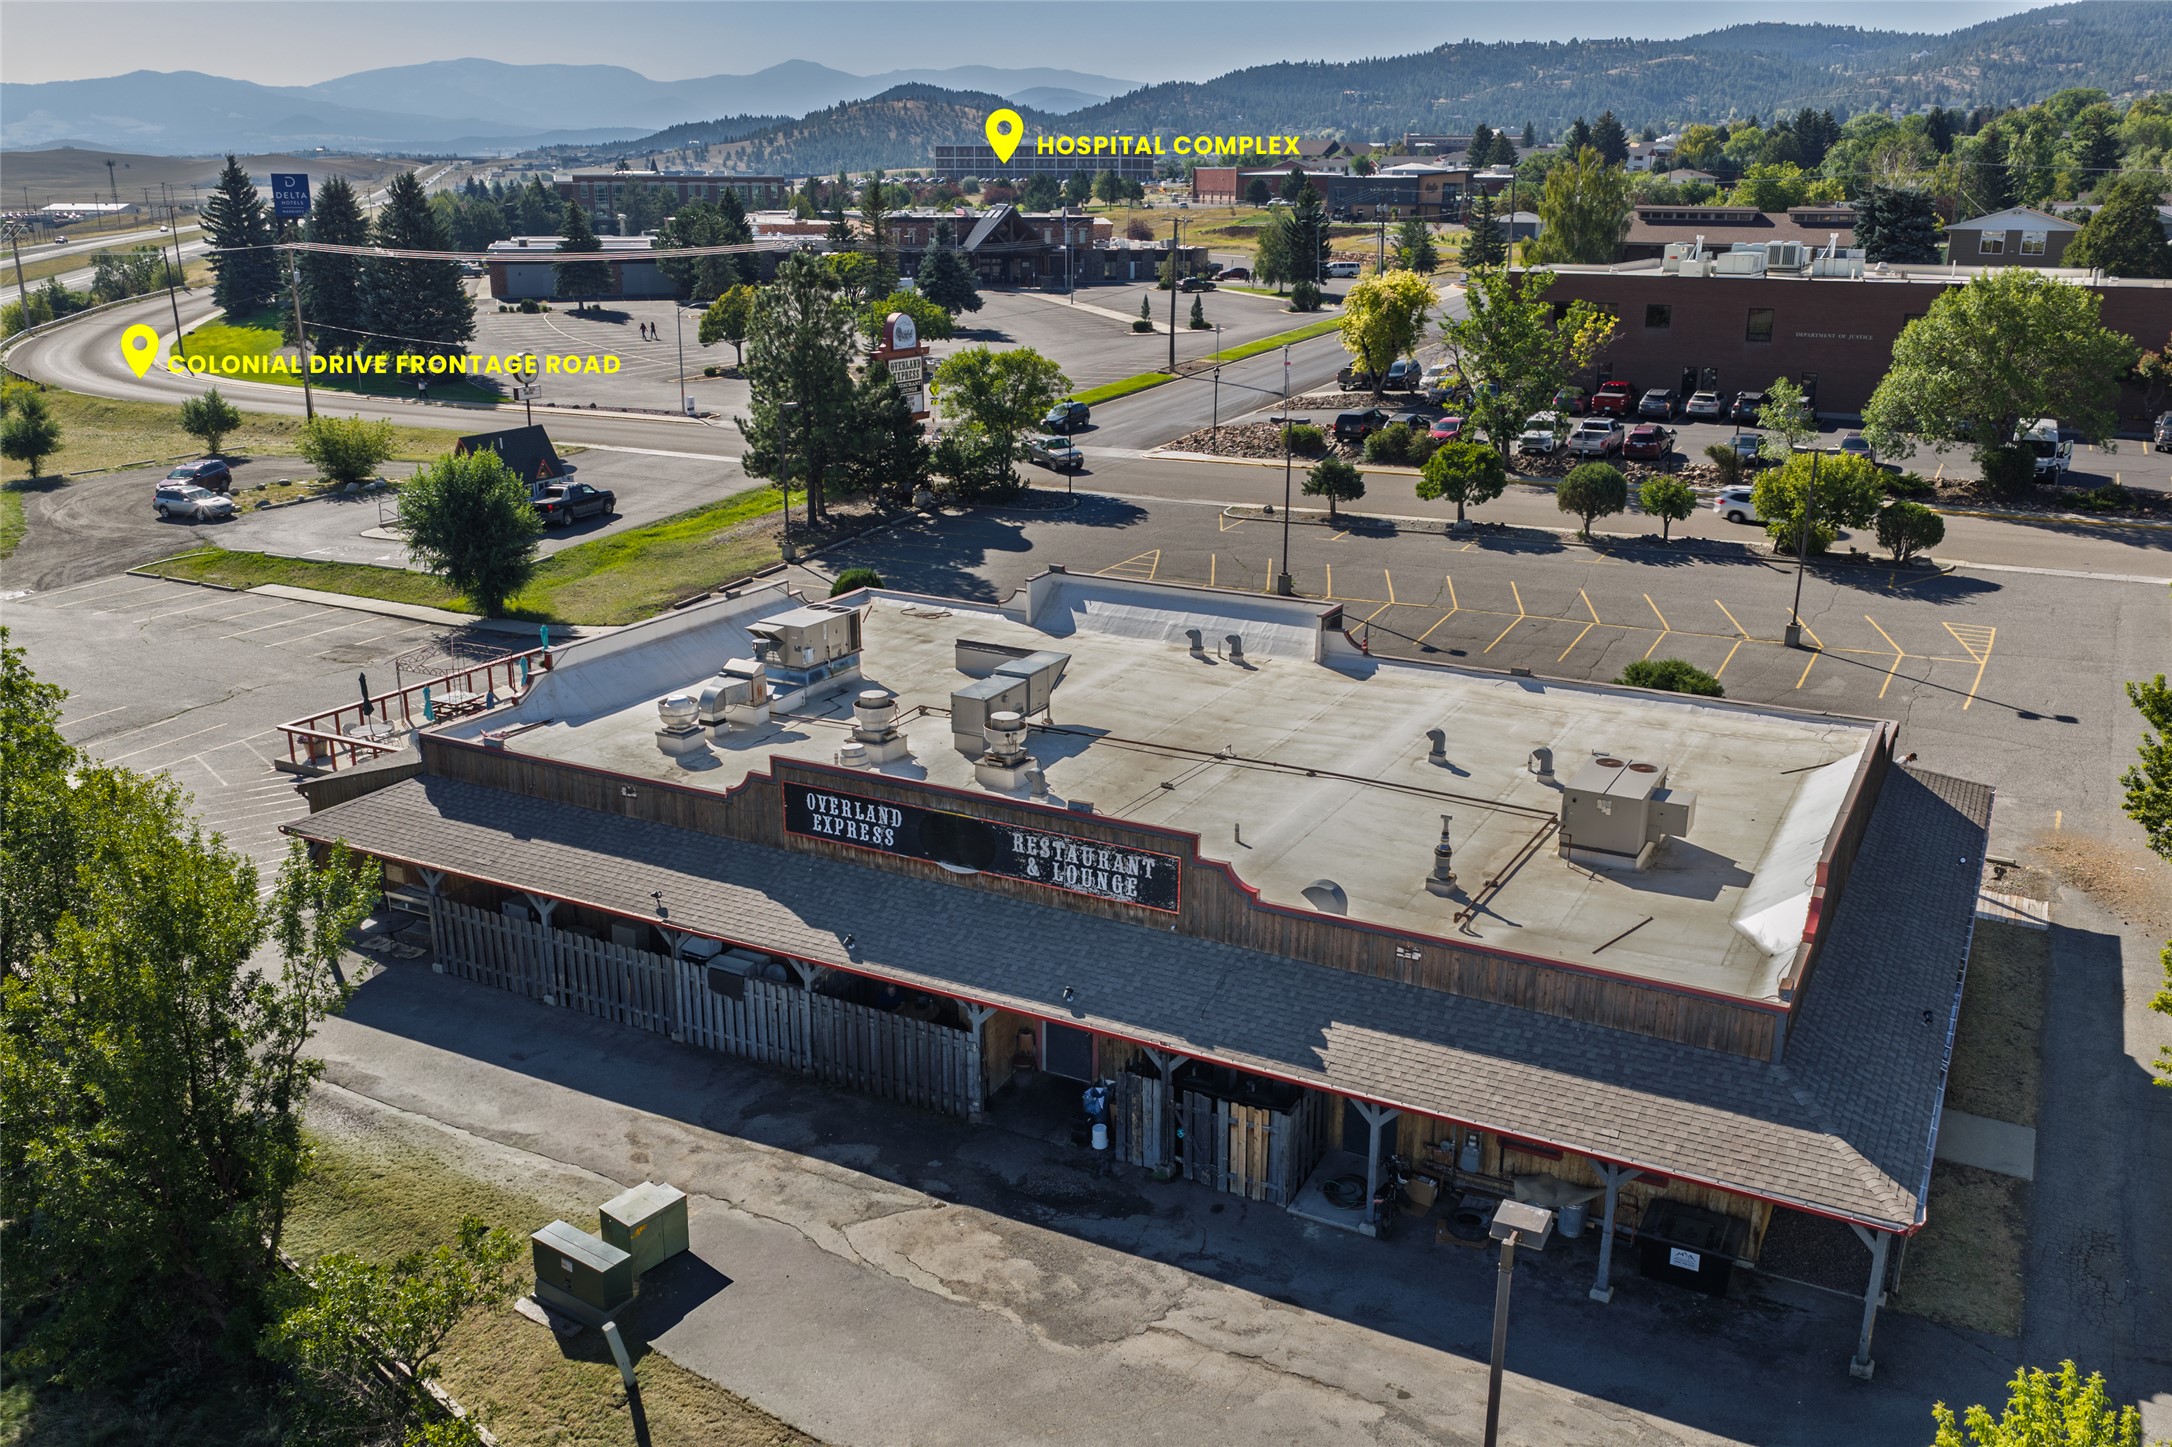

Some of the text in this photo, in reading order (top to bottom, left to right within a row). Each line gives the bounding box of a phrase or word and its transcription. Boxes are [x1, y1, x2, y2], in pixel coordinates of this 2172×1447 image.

[275, 191, 308, 199] DELTA
[890, 359, 921, 372] OVERLAND
[893, 369, 920, 381] XPRESS
[806, 793, 902, 828] OVERLAND
[812, 813, 894, 846] EXPRESS
[1012, 833, 1156, 879] RESTAURANT
[1026, 857, 1138, 897] & LOUNGE
